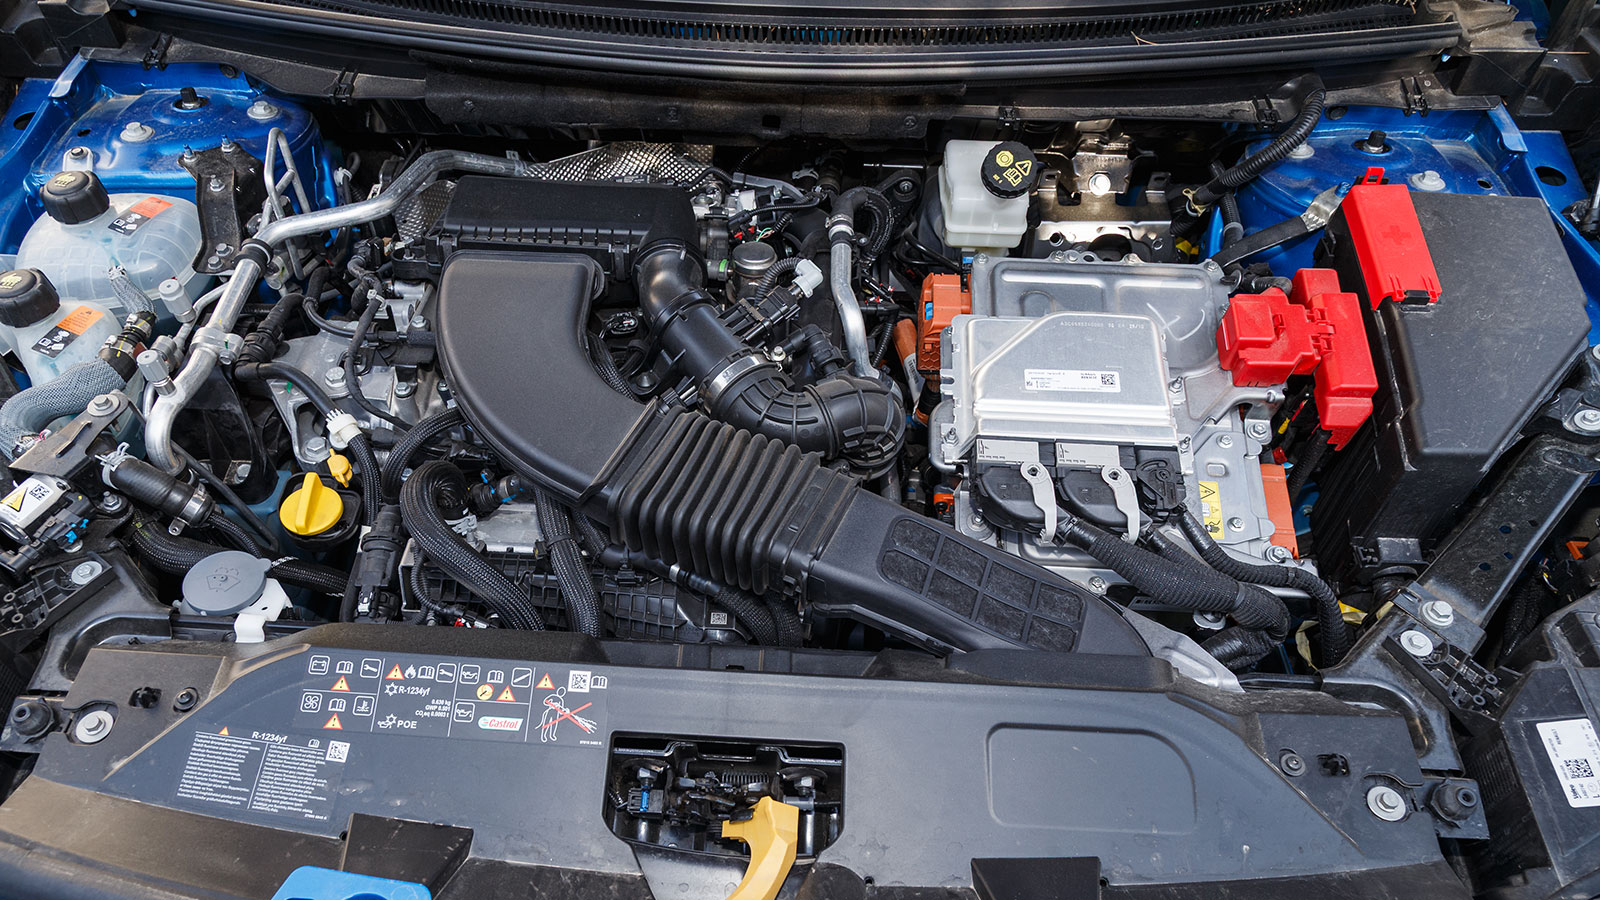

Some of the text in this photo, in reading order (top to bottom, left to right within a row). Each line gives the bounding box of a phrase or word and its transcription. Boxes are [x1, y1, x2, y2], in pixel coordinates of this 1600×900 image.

[398, 685, 431, 697] R-1234yf
[396, 720, 418, 728] POE
[488, 718, 518, 729] Castrol
[252, 731, 288, 744] R-1234yf
